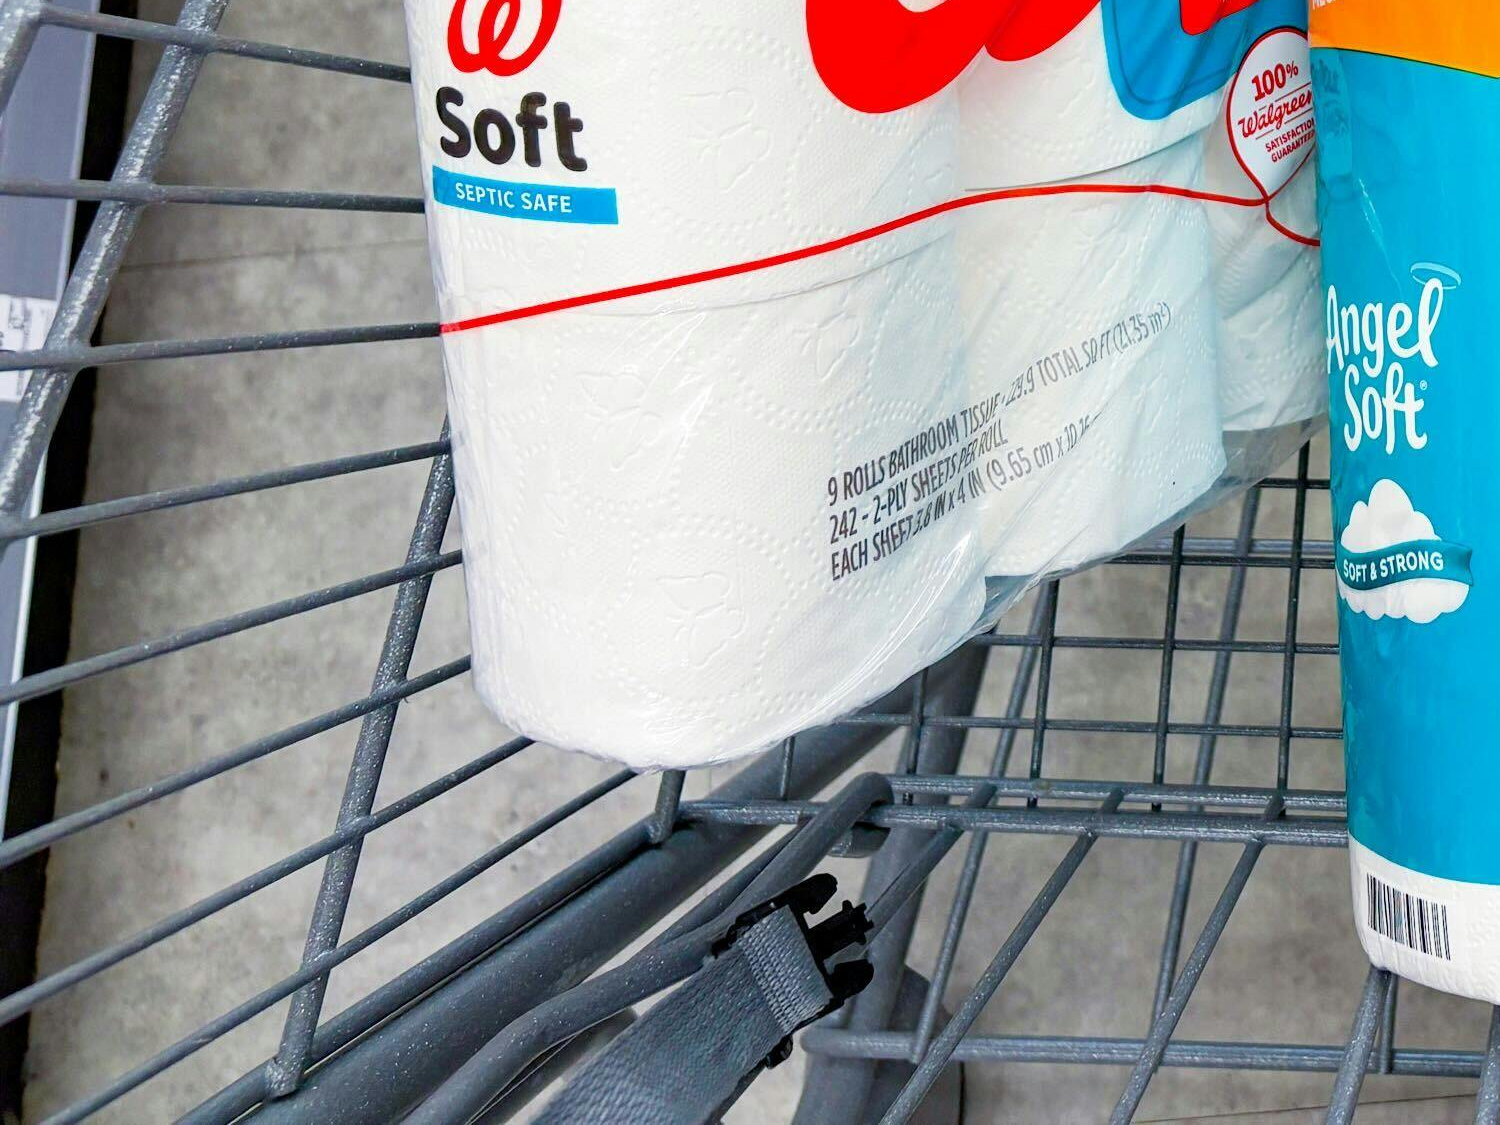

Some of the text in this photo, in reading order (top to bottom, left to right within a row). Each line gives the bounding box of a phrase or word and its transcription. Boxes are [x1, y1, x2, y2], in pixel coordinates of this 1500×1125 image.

[1238, 89, 1312, 138] Walgreen
[1251, 61, 1299, 102] 100%
[435, 86, 588, 172] Soft
[455, 182, 573, 214] SEPTIC SAFE
[1326, 278, 1444, 378] Angel
[827, 476, 838, 506] 9
[843, 456, 886, 500] ROLLS
[888, 415, 959, 479] BATHROOM
[961, 392, 1001, 438] TISSUE
[1036, 346, 1084, 387] TOTAL
[1081, 338, 1099, 368] SQ
[1100, 330, 1112, 360] FT
[829, 507, 858, 545] 242
[873, 478, 908, 525] 2-PLY
[911, 452, 958, 502] SHEETS
[957, 441, 978, 474] PER
[978, 419, 1008, 457] ROLL
[831, 538, 868, 581] EACH
[873, 514, 914, 562] SHEET
[912, 502, 933, 538] 3.8
[934, 491, 946, 520] IN
[957, 476, 966, 504] 4
[968, 468, 986, 499] IN
[986, 447, 1032, 492] (9.65
[1033, 442, 1054, 469] cm
[1343, 550, 1444, 583] SOFT & STRONG
